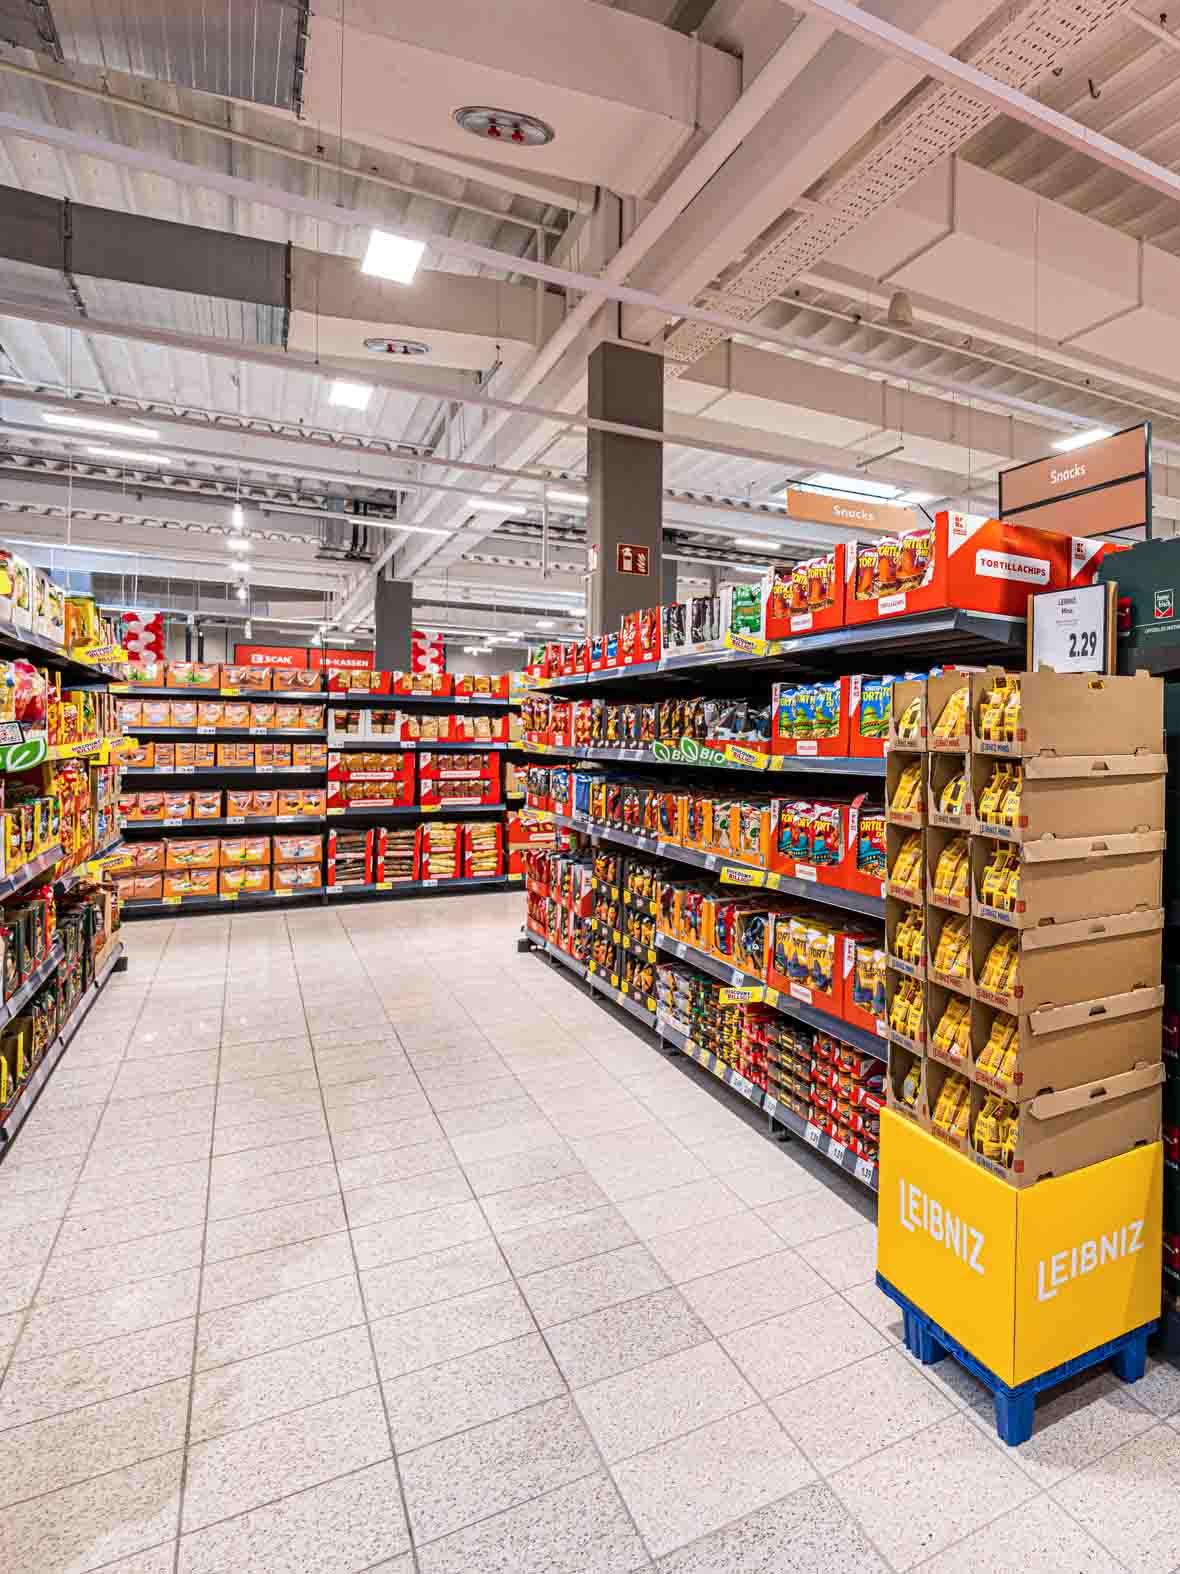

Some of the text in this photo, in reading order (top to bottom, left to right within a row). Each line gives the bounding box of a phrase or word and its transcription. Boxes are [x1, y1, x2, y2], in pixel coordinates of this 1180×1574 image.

[1050, 464, 1086, 485] Snacks
[832, 503, 875, 522] Snacks
[980, 557, 1047, 577] TORTILLACHIPS
[1069, 632, 1097, 658] 2.29
[265, 655, 292, 665] SCAN
[700, 748, 725, 763] BIO
[899, 1177, 985, 1275] LEIBNIZ
[1036, 1219, 1145, 1303] LEIBNIZ
